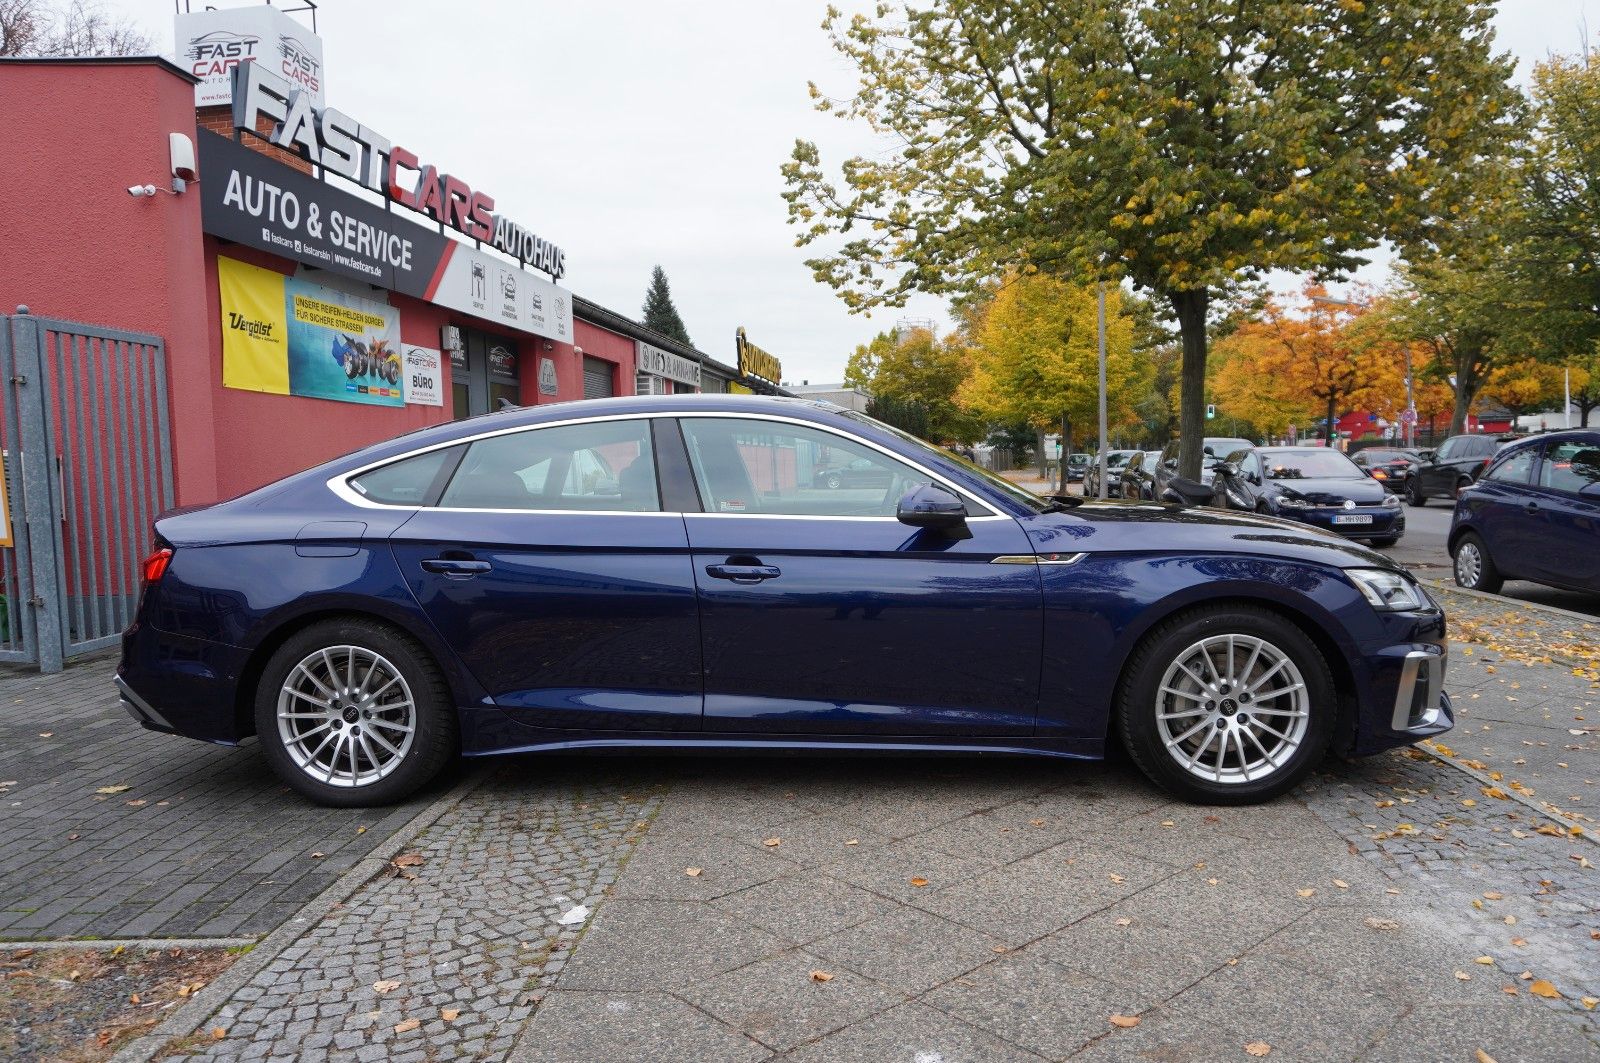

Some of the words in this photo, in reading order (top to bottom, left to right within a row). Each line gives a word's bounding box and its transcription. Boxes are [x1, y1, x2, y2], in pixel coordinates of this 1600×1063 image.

[195, 40, 259, 60] FAST
[283, 43, 319, 75] FAST
[281, 60, 319, 92] CARS
[223, 169, 300, 231] AUTO
[306, 202, 323, 239] &
[330, 210, 413, 272] SERVICE
[271, 232, 294, 249] fastcars
[334, 252, 382, 277] www.fastcars.de
[493, 214, 566, 279] AUTOHAUS
[229, 311, 273, 337] Vergölst
[295, 296, 320, 312] UNSERE
[320, 304, 364, 323] REIFEN-HELDEN
[364, 315, 385, 328] SORGEN
[296, 308, 309, 320] FÜR
[309, 312, 335, 327] SICHERE
[412, 373, 433, 389] BÜRO
